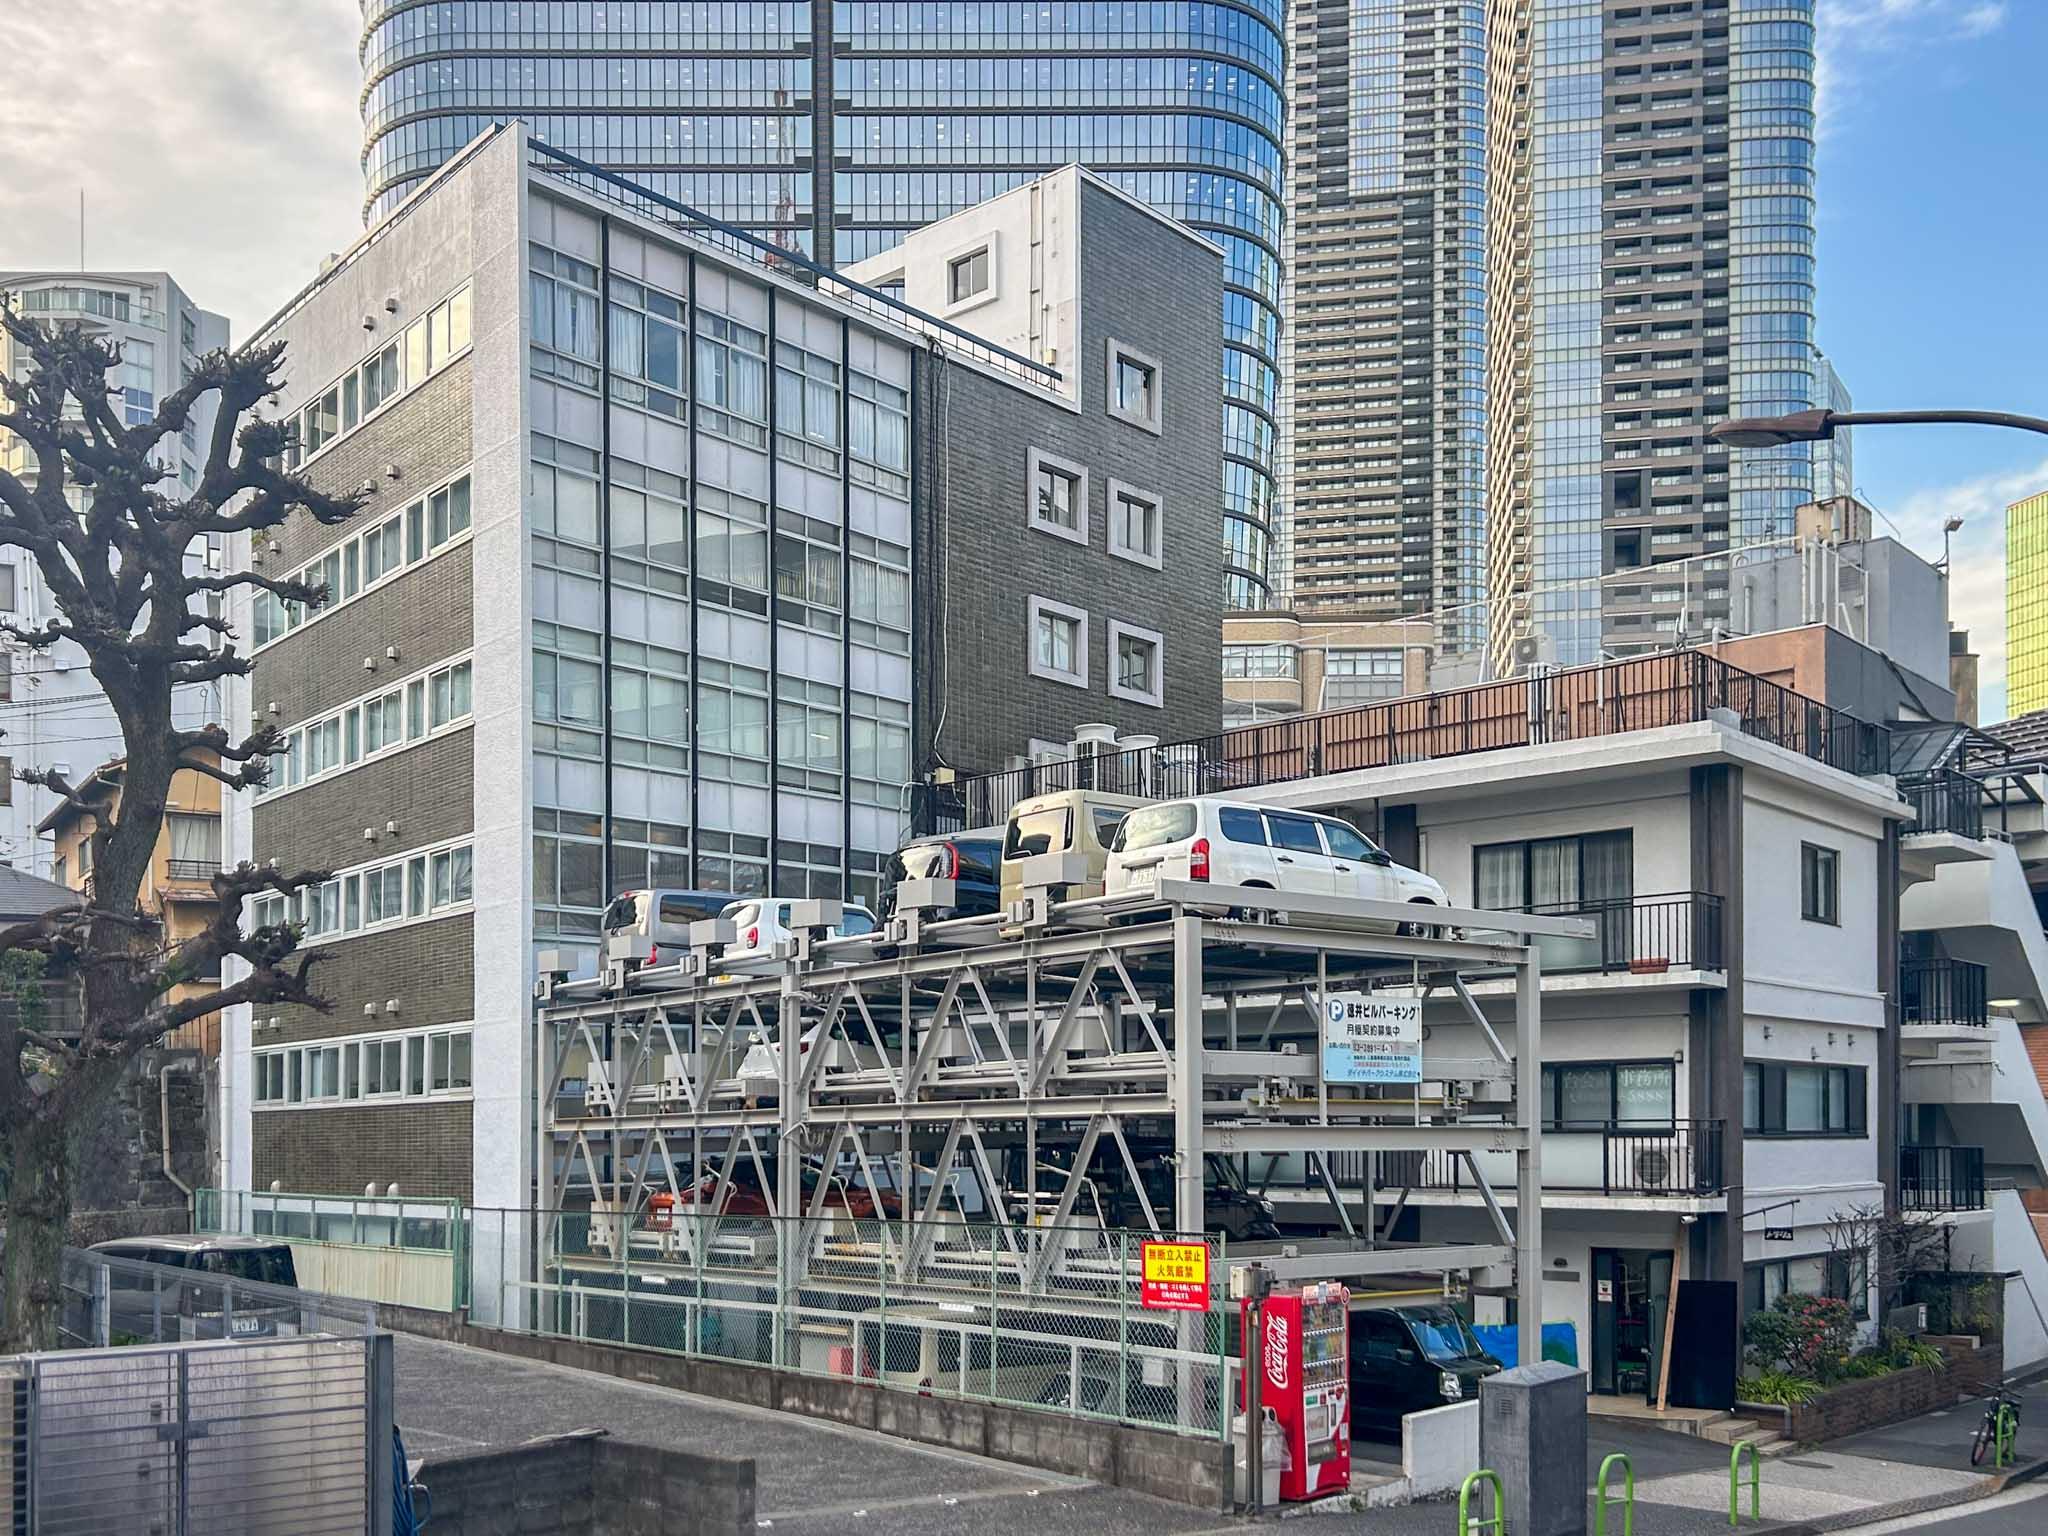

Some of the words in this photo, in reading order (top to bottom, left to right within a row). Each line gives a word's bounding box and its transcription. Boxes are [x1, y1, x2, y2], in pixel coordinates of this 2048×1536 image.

[1347, 1024, 1400, 1036] 月極契約募集中
[1149, 1249, 1201, 1262] 無断立入禁止
[1156, 1265, 1193, 1278] 火気厳禁
[1267, 1311, 1288, 1389] Coca-Cola
